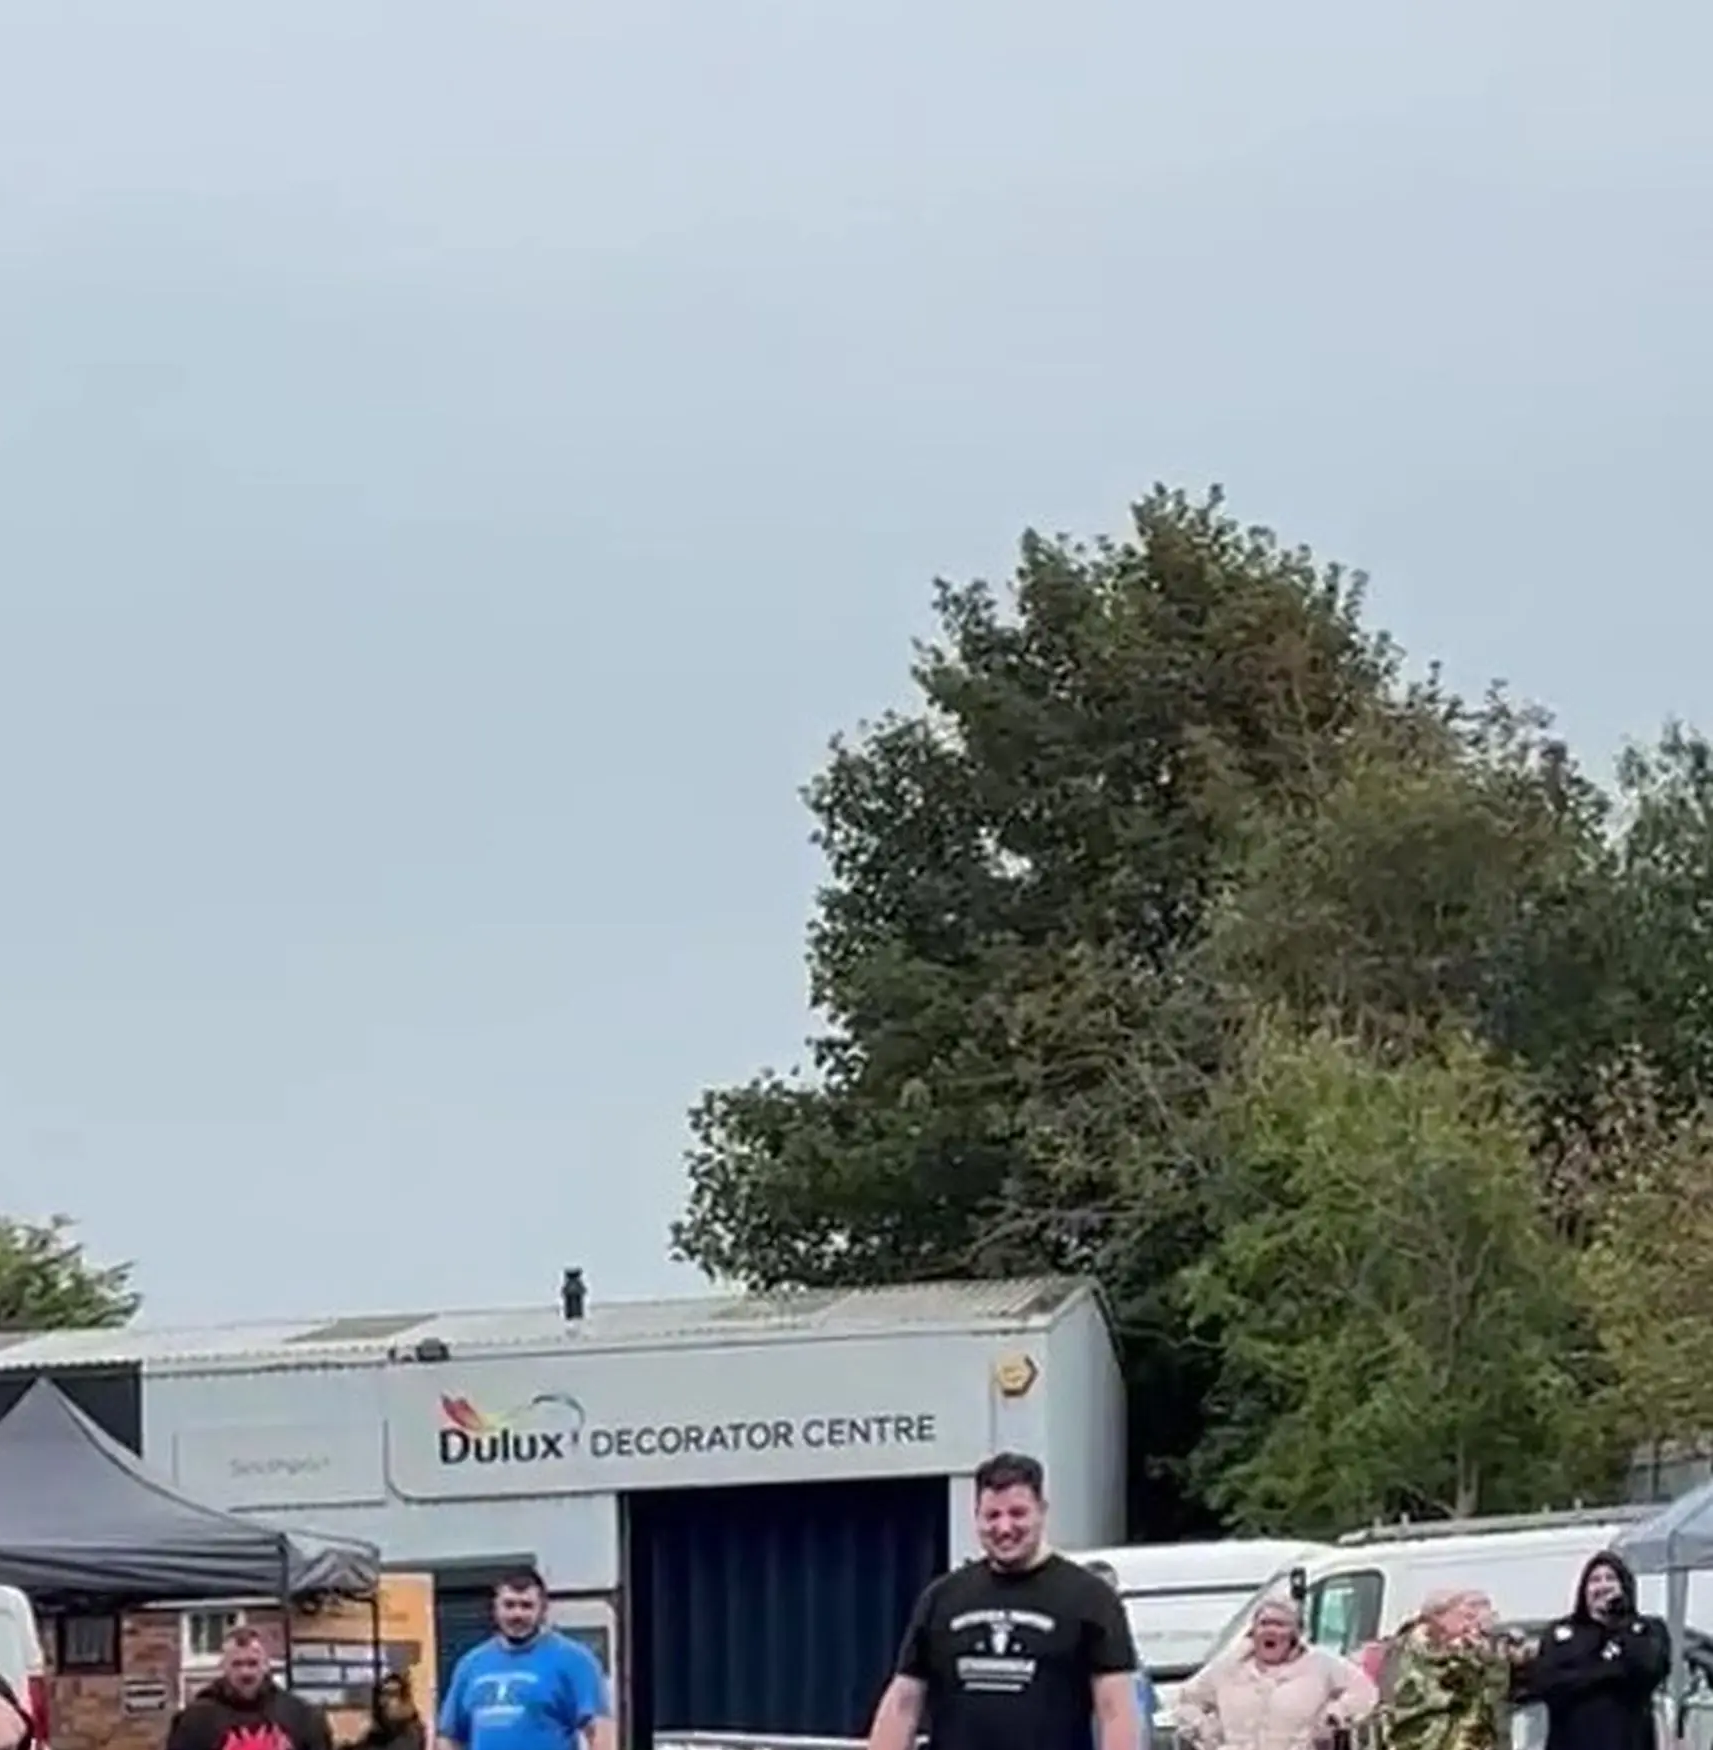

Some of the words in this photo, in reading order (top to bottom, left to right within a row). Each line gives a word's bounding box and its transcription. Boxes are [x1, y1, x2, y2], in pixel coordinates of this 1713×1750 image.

[439, 1428, 564, 1465] Dulux
[590, 1419, 795, 1458] DECORATOR
[802, 1413, 937, 1449] CENTRE
